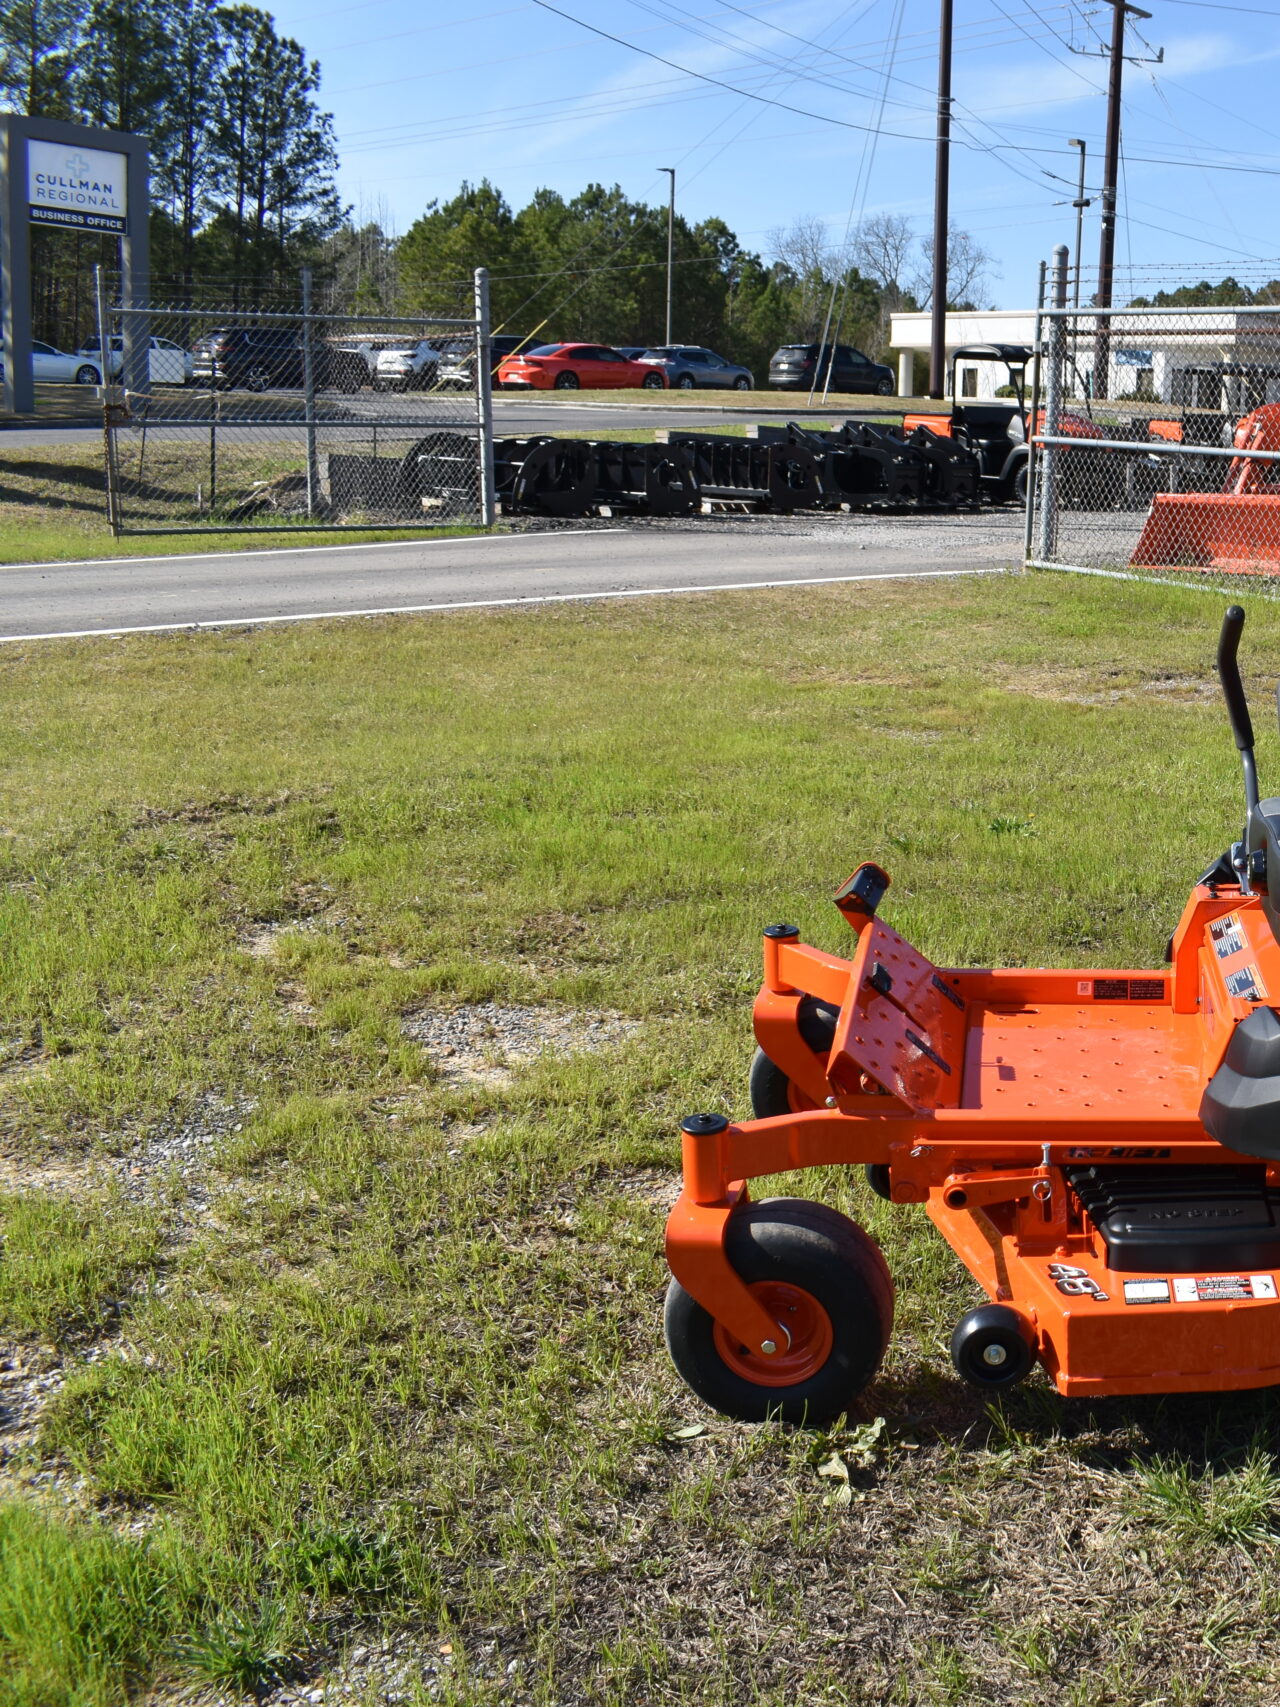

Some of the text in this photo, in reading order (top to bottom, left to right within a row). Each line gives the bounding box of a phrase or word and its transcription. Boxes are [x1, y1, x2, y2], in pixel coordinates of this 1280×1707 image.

[35, 173, 113, 194] CULLMAN
[36, 187, 120, 209] REGIONAL
[32, 209, 123, 229] BUSINESS OFFICE
